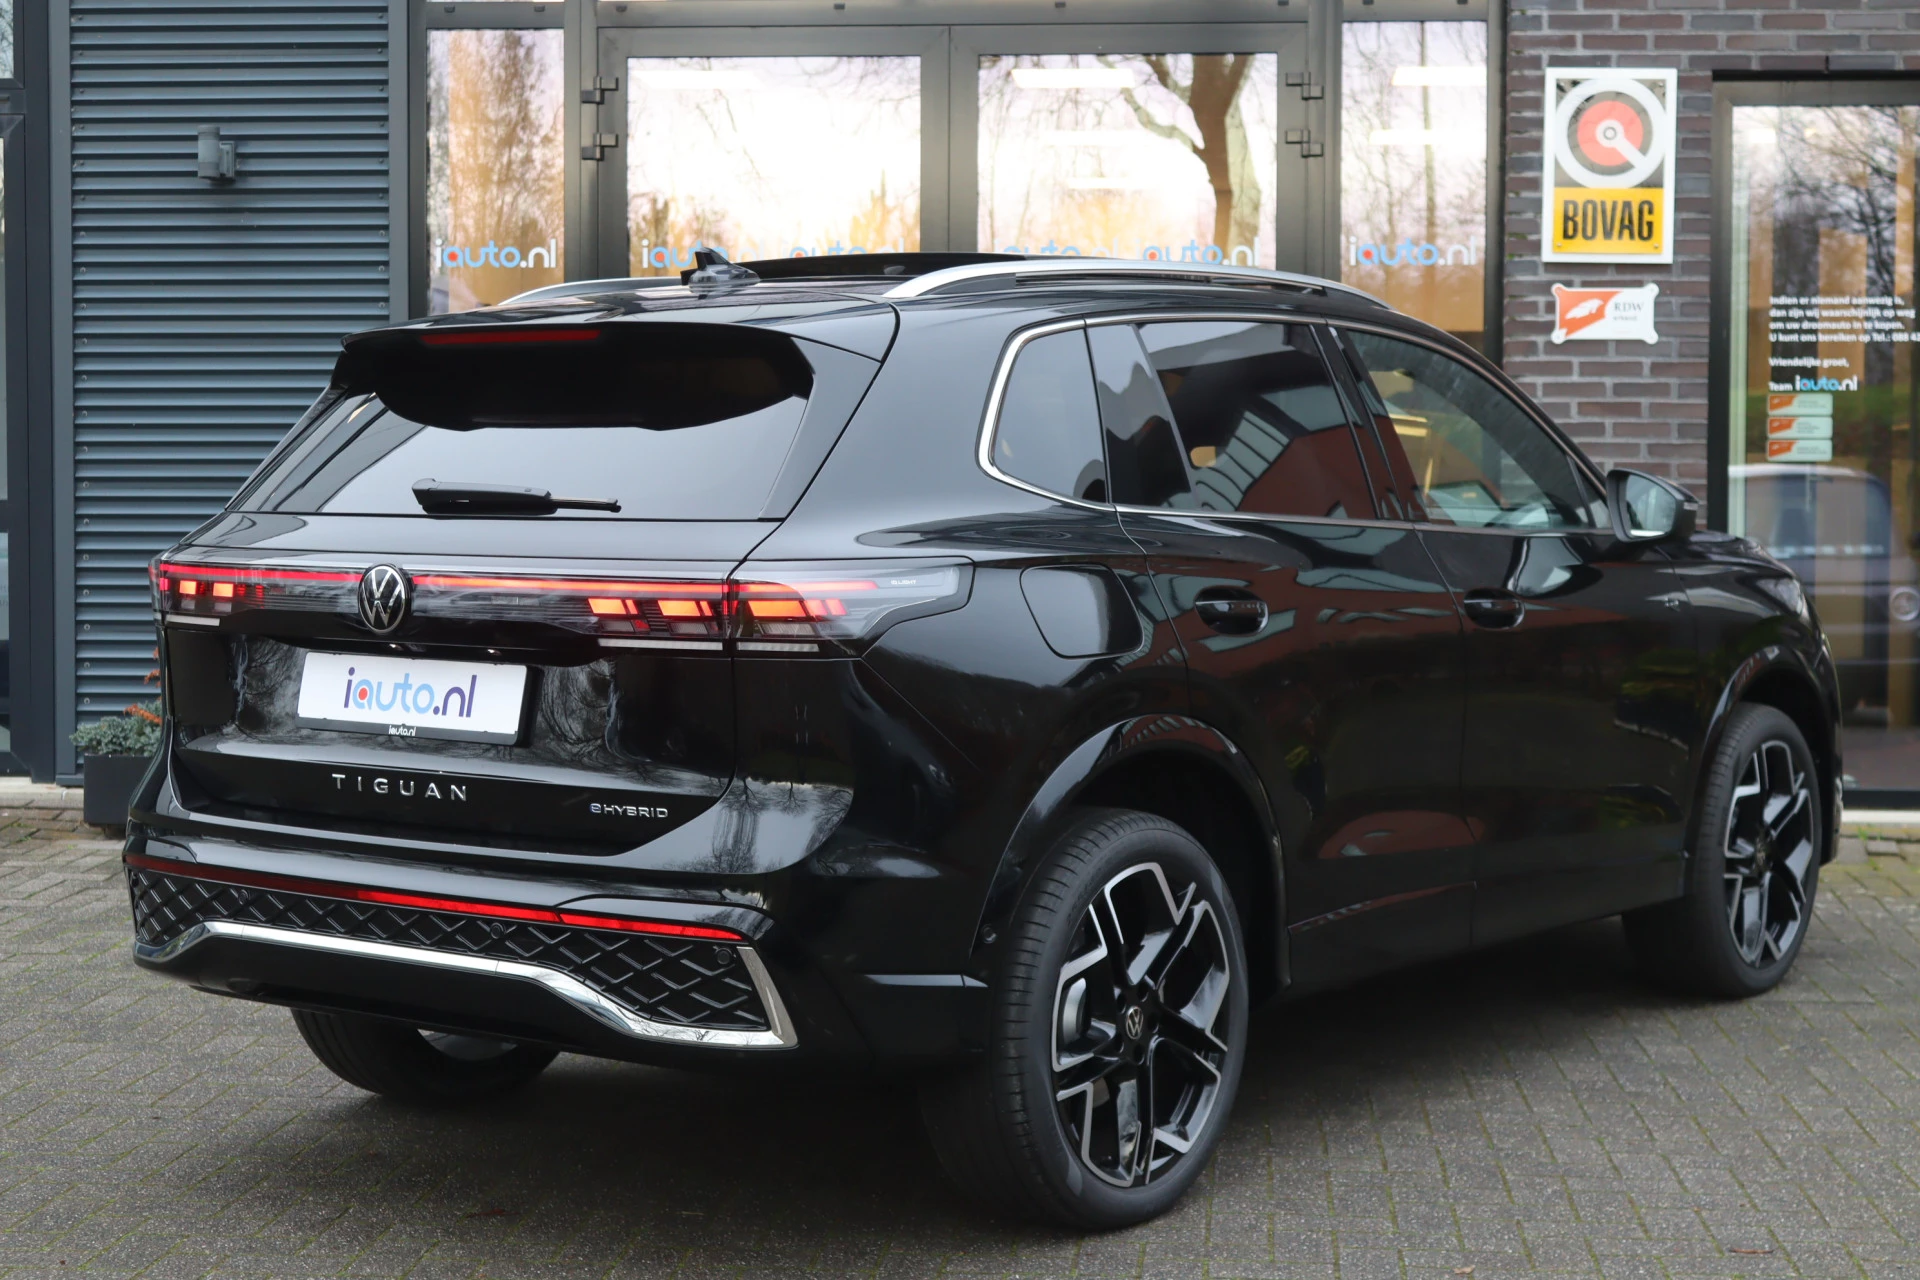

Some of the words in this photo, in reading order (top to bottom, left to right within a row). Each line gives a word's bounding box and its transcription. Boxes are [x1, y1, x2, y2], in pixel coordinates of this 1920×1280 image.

[1562, 199, 1655, 241] BOVAG
[435, 238, 557, 268] iauto.nl
[641, 238, 764, 268] iaunl
[1349, 236, 1477, 266] iauto.nl
[1613, 301, 1645, 313] RDW
[1769, 333, 1777, 342] U
[1768, 356, 1821, 368] Vriendelijke
[1768, 381, 1793, 391] Team
[1795, 375, 1858, 391] iauto.nl
[344, 666, 478, 718] iauto.nl
[388, 724, 417, 737] iauto.nl
[331, 773, 467, 801] TIGUAN
